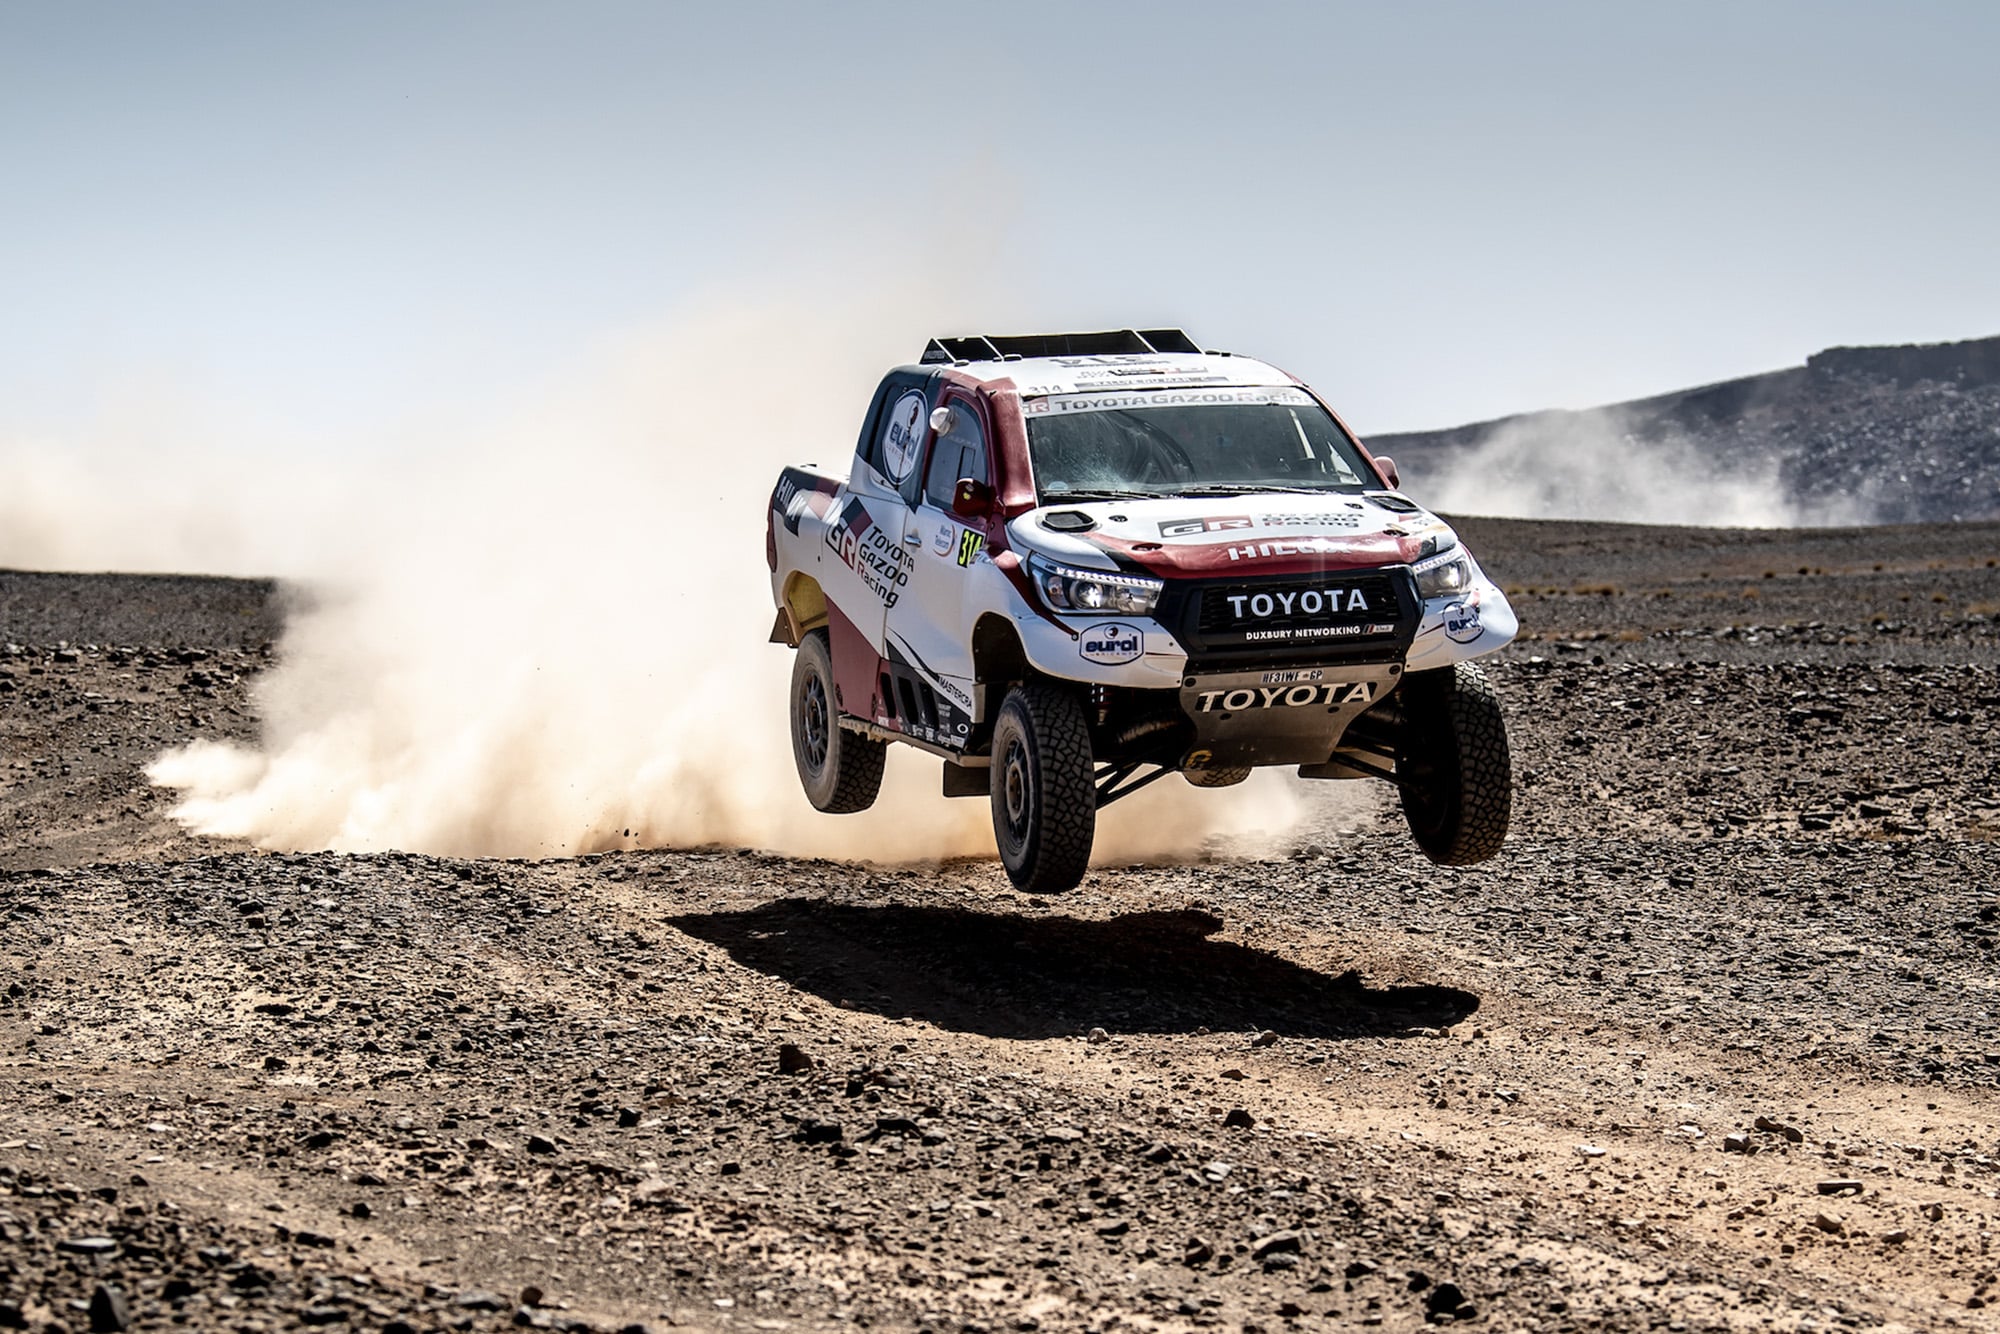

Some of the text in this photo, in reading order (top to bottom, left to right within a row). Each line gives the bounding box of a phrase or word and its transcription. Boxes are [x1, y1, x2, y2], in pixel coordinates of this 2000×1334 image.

[1055, 396, 1147, 411] TOYOTA
[1151, 393, 1234, 405] GAZOO
[1160, 518, 1251, 537] GR
[867, 526, 915, 572] TOYOTA
[859, 543, 908, 587] GAZOO
[857, 560, 900, 609] Racing
[1227, 588, 1369, 618] TOYOTA
[1085, 635, 1138, 652] eurol
[1246, 630, 1293, 641] DUXBURY
[1295, 625, 1361, 638] NETWORKING
[1200, 681, 1372, 713] TOYOTA
